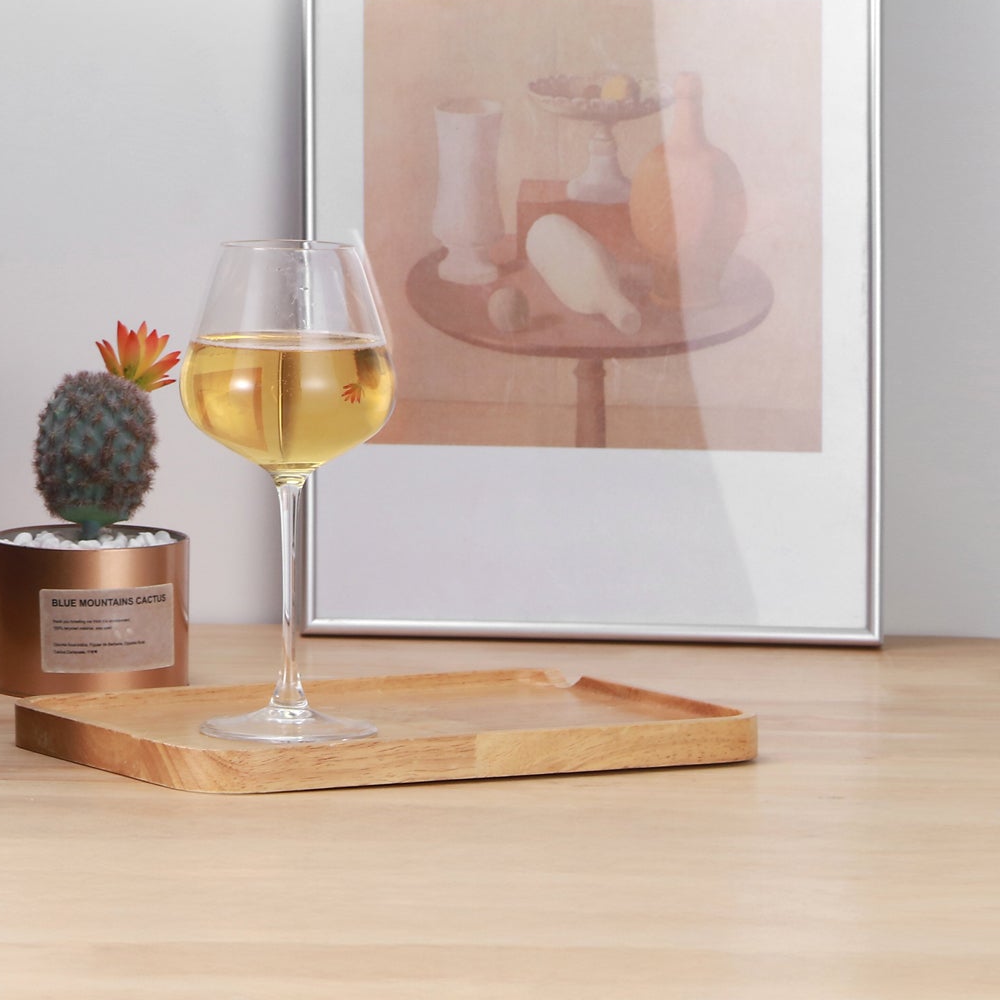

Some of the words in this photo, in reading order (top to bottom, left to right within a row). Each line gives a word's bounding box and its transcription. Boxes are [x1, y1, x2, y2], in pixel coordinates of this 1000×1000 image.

[51, 598, 77, 608] BLUE
[79, 597, 134, 608] MOUNTAINS
[135, 594, 167, 605] CACTUS
